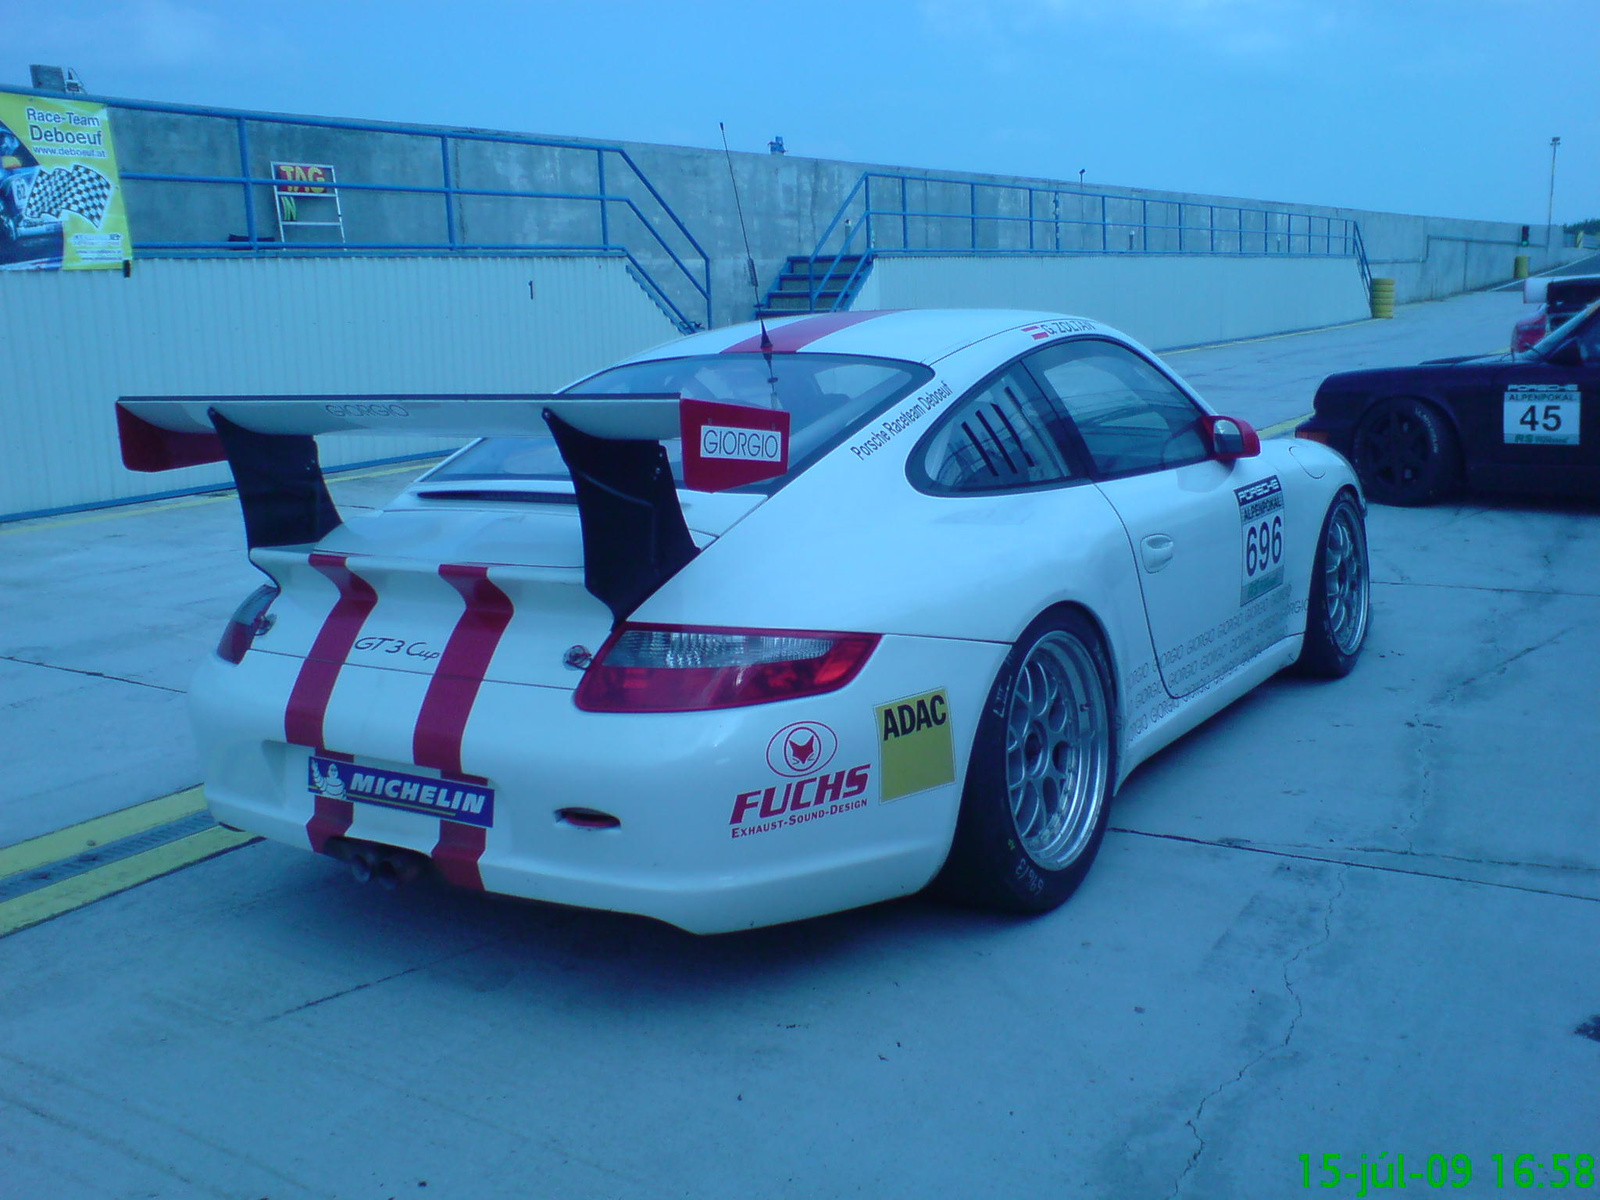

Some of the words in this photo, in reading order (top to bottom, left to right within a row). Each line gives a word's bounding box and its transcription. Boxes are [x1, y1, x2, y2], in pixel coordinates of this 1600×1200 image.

[26, 108, 101, 126] Race-Team
[29, 124, 103, 145] Deboeuf
[33, 146, 106, 158] www.deboeuf.at
[280, 165, 325, 193] TAG
[1053, 320, 1097, 333] ZOLTAN
[324, 404, 410, 417] GIORGIO
[850, 431, 891, 461] Porsche
[882, 403, 927, 436] Raceteam
[917, 380, 954, 411] Deboeuf
[1519, 405, 1562, 432] 45
[703, 429, 779, 459] GIORGIO
[1237, 478, 1280, 502] PORSCHE
[1246, 515, 1282, 577] 696
[406, 642, 441, 661] Cup
[883, 694, 947, 741] ADAC
[350, 773, 486, 815] MICHELIN
[729, 763, 871, 826] FUCHS
